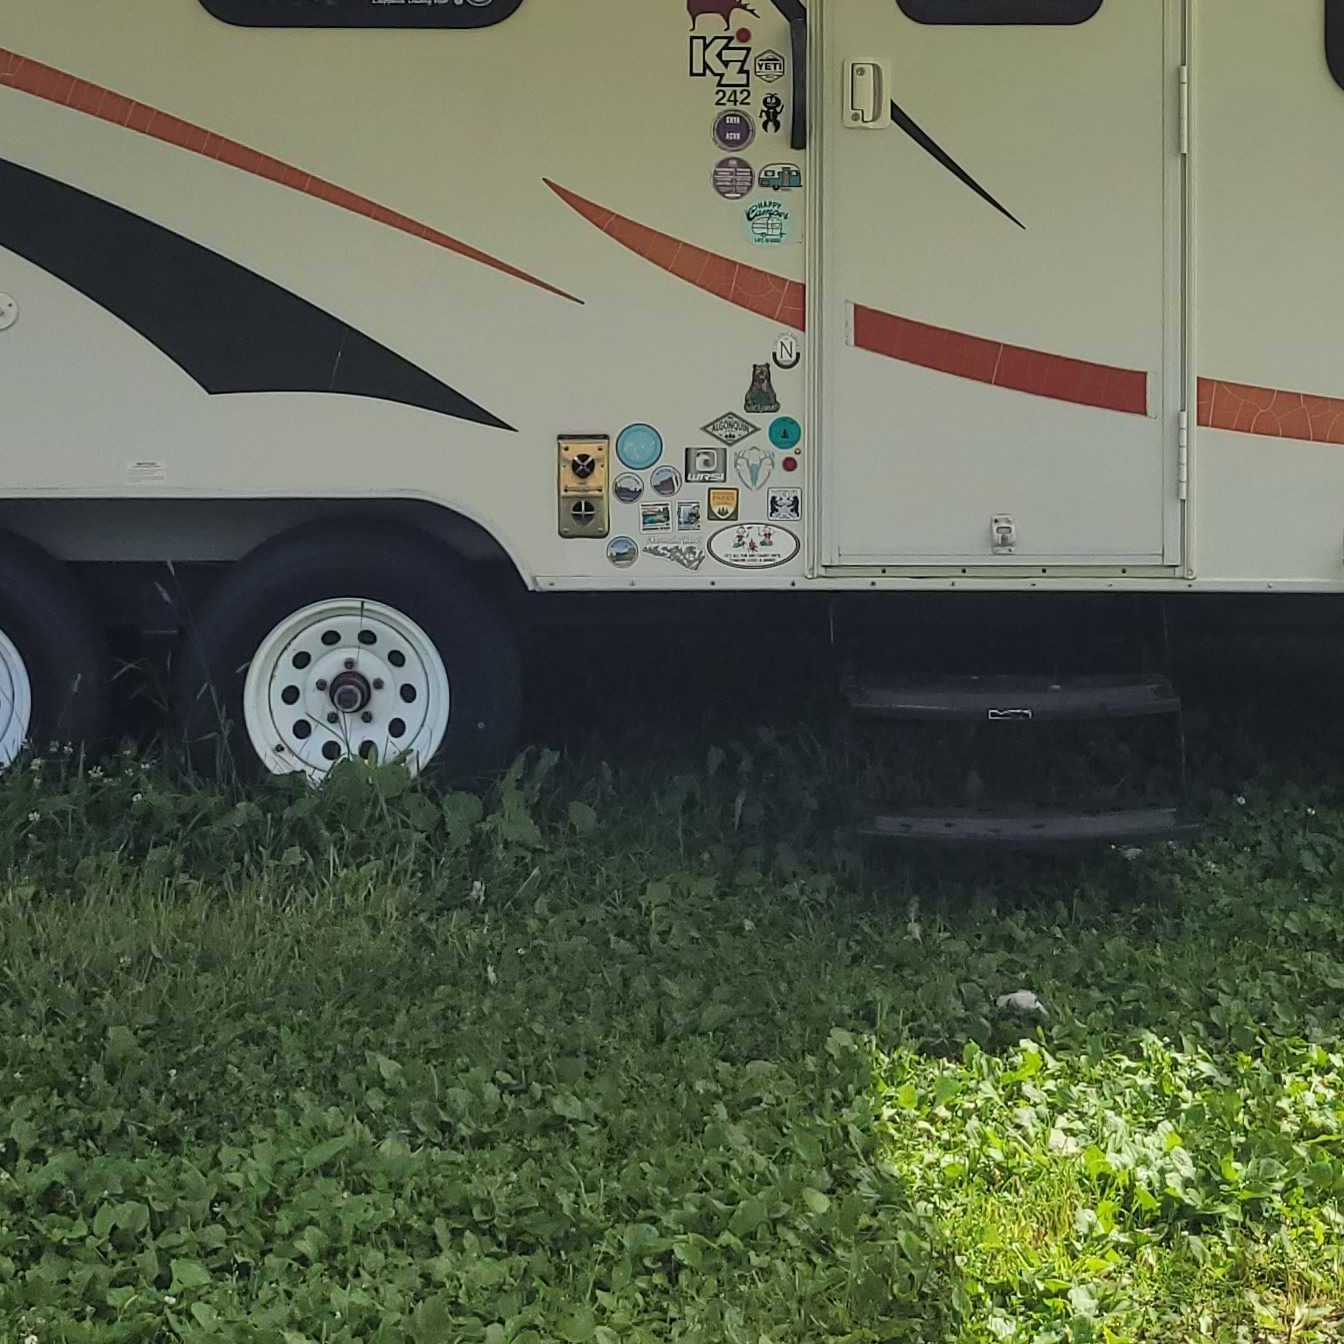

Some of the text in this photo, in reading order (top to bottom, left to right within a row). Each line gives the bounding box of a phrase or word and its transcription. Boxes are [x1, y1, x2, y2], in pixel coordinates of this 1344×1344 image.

[757, 62, 782, 71] YETI
[714, 89, 752, 106] 242
[711, 419, 750, 433] ALGONQUIN
